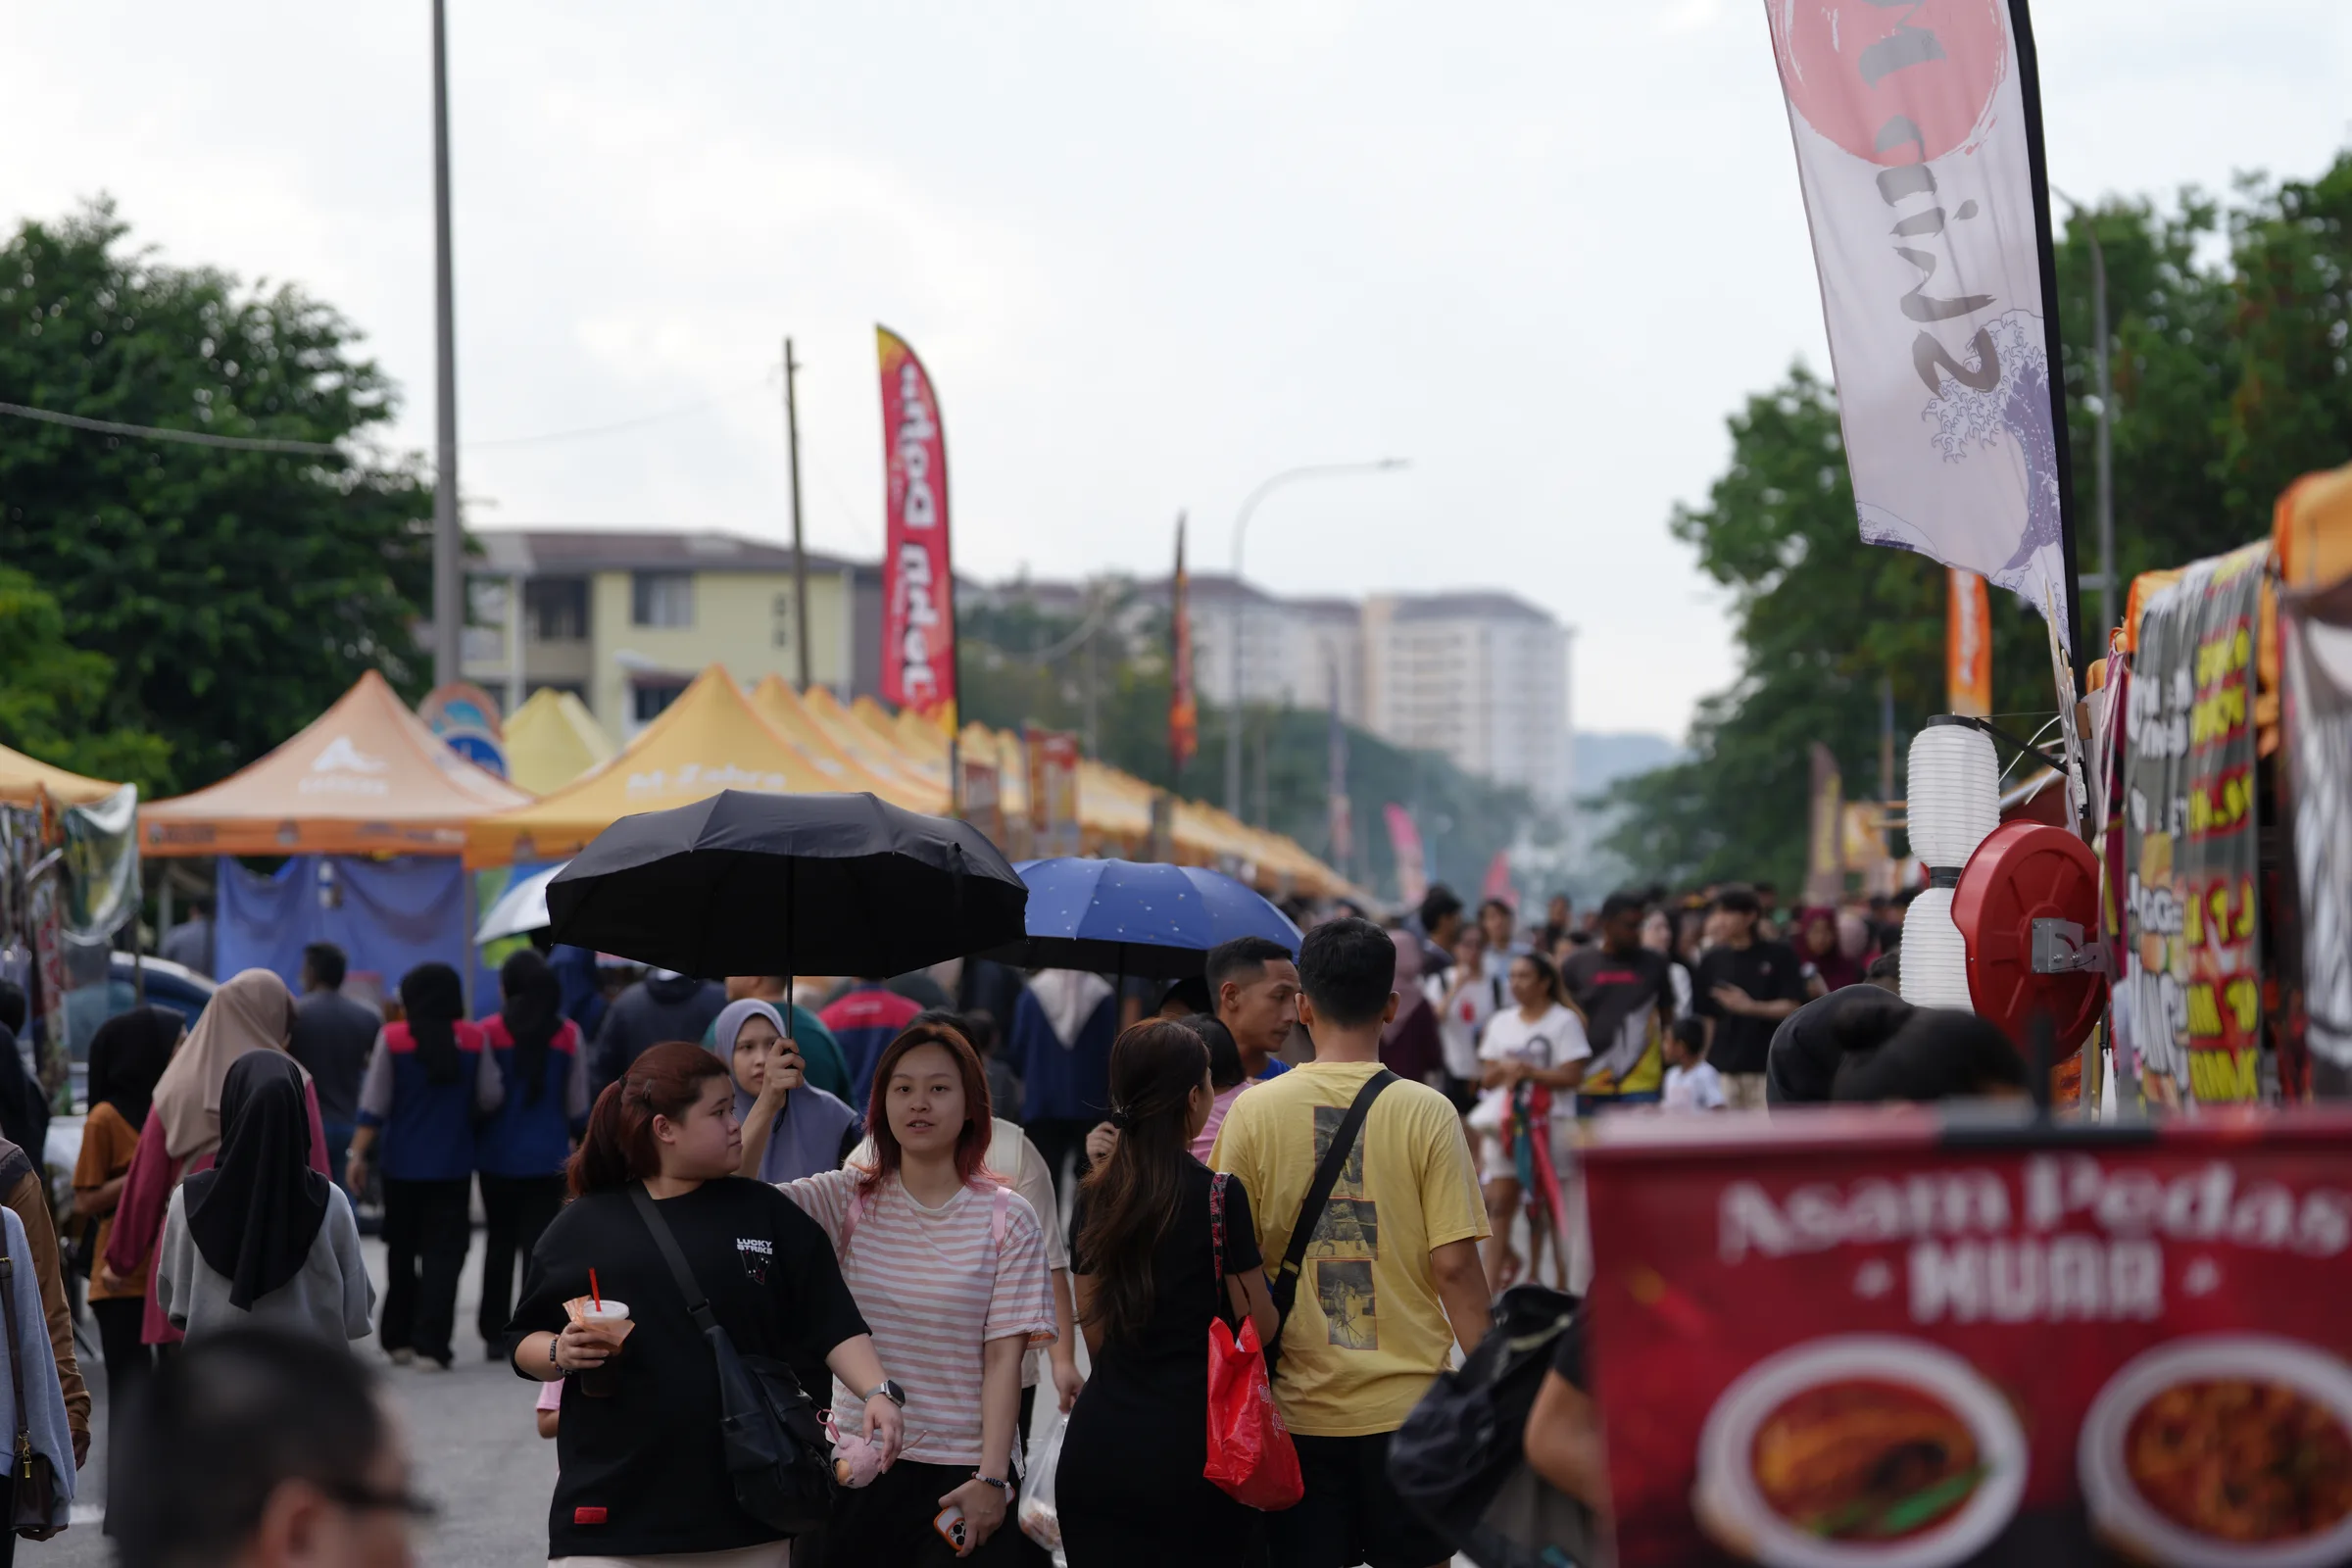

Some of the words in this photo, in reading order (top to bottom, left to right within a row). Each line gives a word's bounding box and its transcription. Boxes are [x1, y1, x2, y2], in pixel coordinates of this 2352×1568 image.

[1717, 1169, 2012, 1267] Asam
[2024, 1152, 2351, 1258] Pedas
[736, 1238, 772, 1249] LUCKY
[736, 1244, 773, 1255] STRIKE
[1907, 1233, 2166, 1325] MUAR
